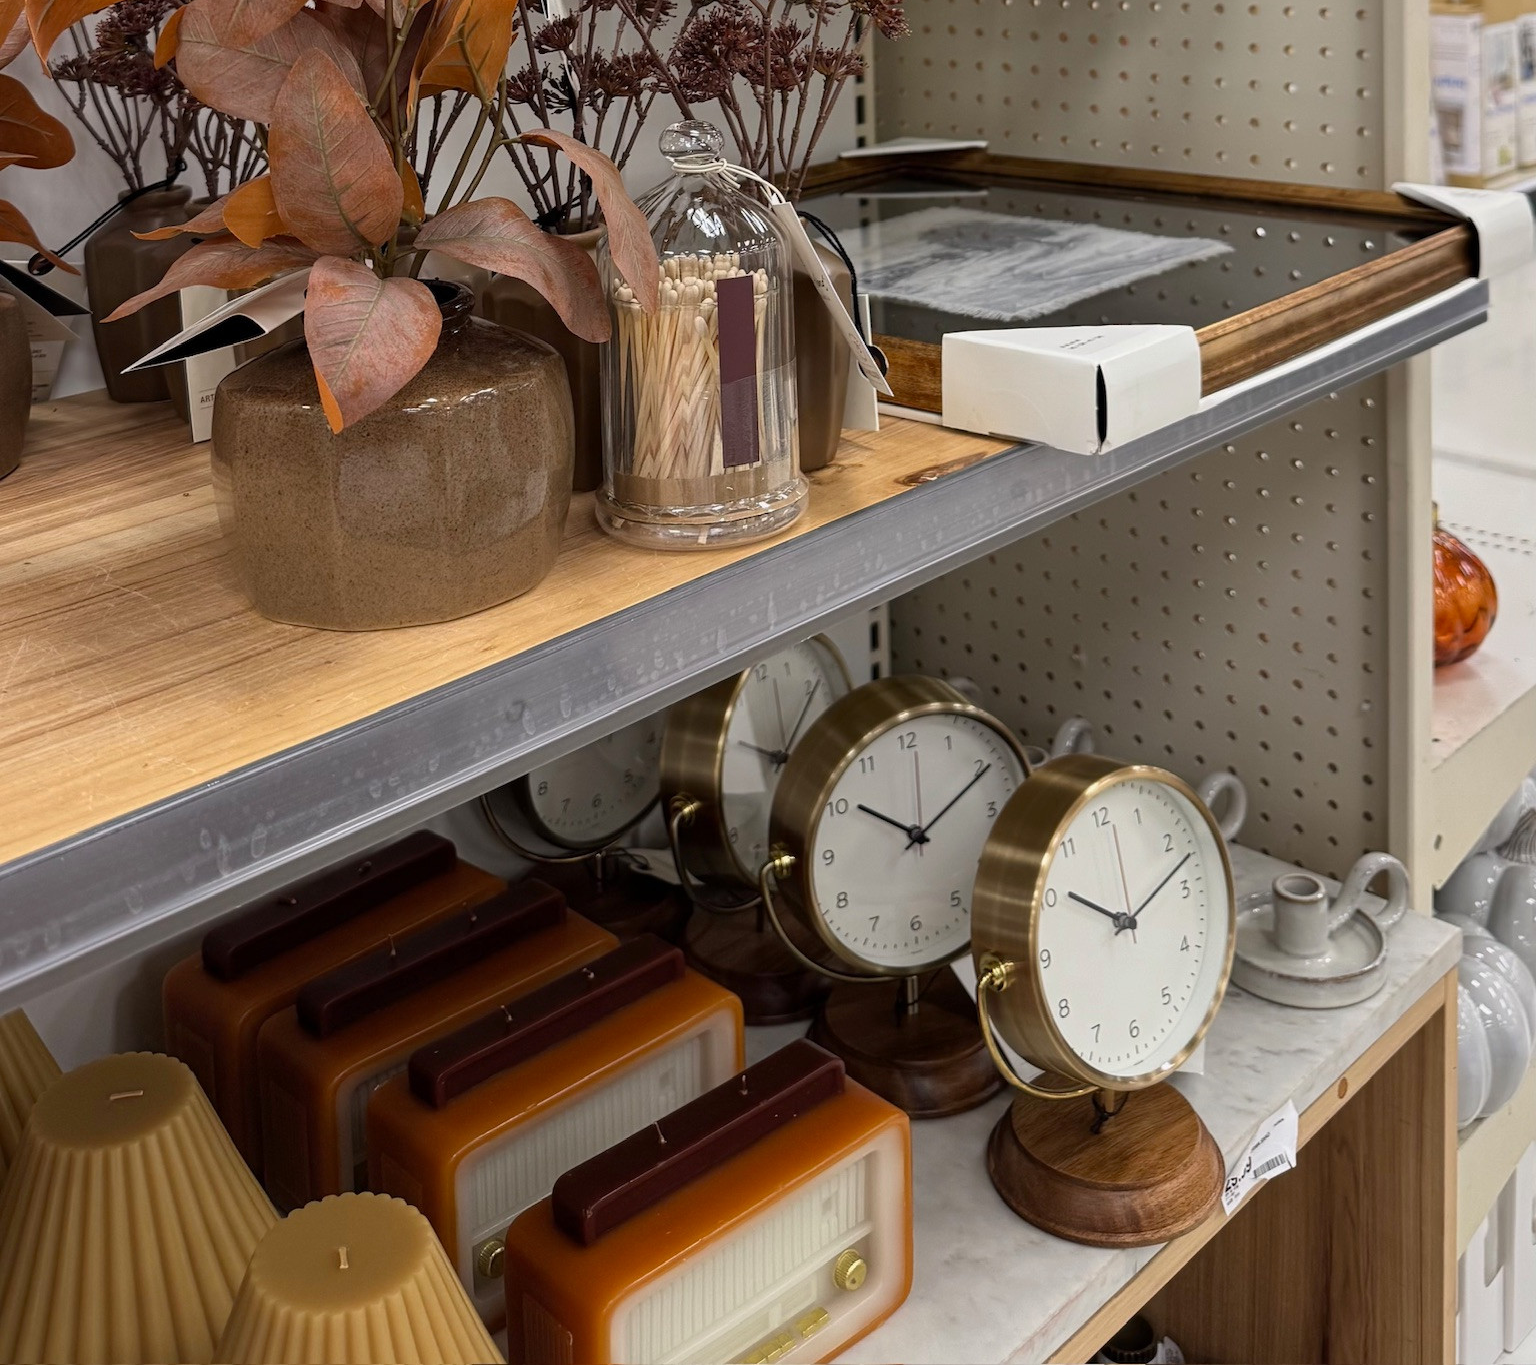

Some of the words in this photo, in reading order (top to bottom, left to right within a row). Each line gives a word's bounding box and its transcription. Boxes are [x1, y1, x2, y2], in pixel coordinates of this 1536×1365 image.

[897, 731, 917, 750] 12
[944, 735, 952, 751] 1
[858, 755, 875, 774] 11
[825, 797, 849, 817] 10
[987, 800, 997, 818] 3
[1133, 807, 1142, 825] 1
[1091, 806, 1111, 828] 12
[1059, 837, 1076, 858] 11
[1163, 833, 1174, 853] 2
[822, 849, 835, 866] 9
[1181, 879, 1190, 899] 3
[836, 891, 849, 909] 8
[950, 890, 962, 908] 5
[868, 915, 880, 932] 7
[909, 915, 922, 932] 6
[1179, 935, 1190, 952] 4
[1039, 948, 1052, 969] 9
[1161, 986, 1172, 1006] 5
[1058, 998, 1070, 1019] 8
[1090, 1023, 1101, 1044] 7
[1129, 1019, 1140, 1039] 6
